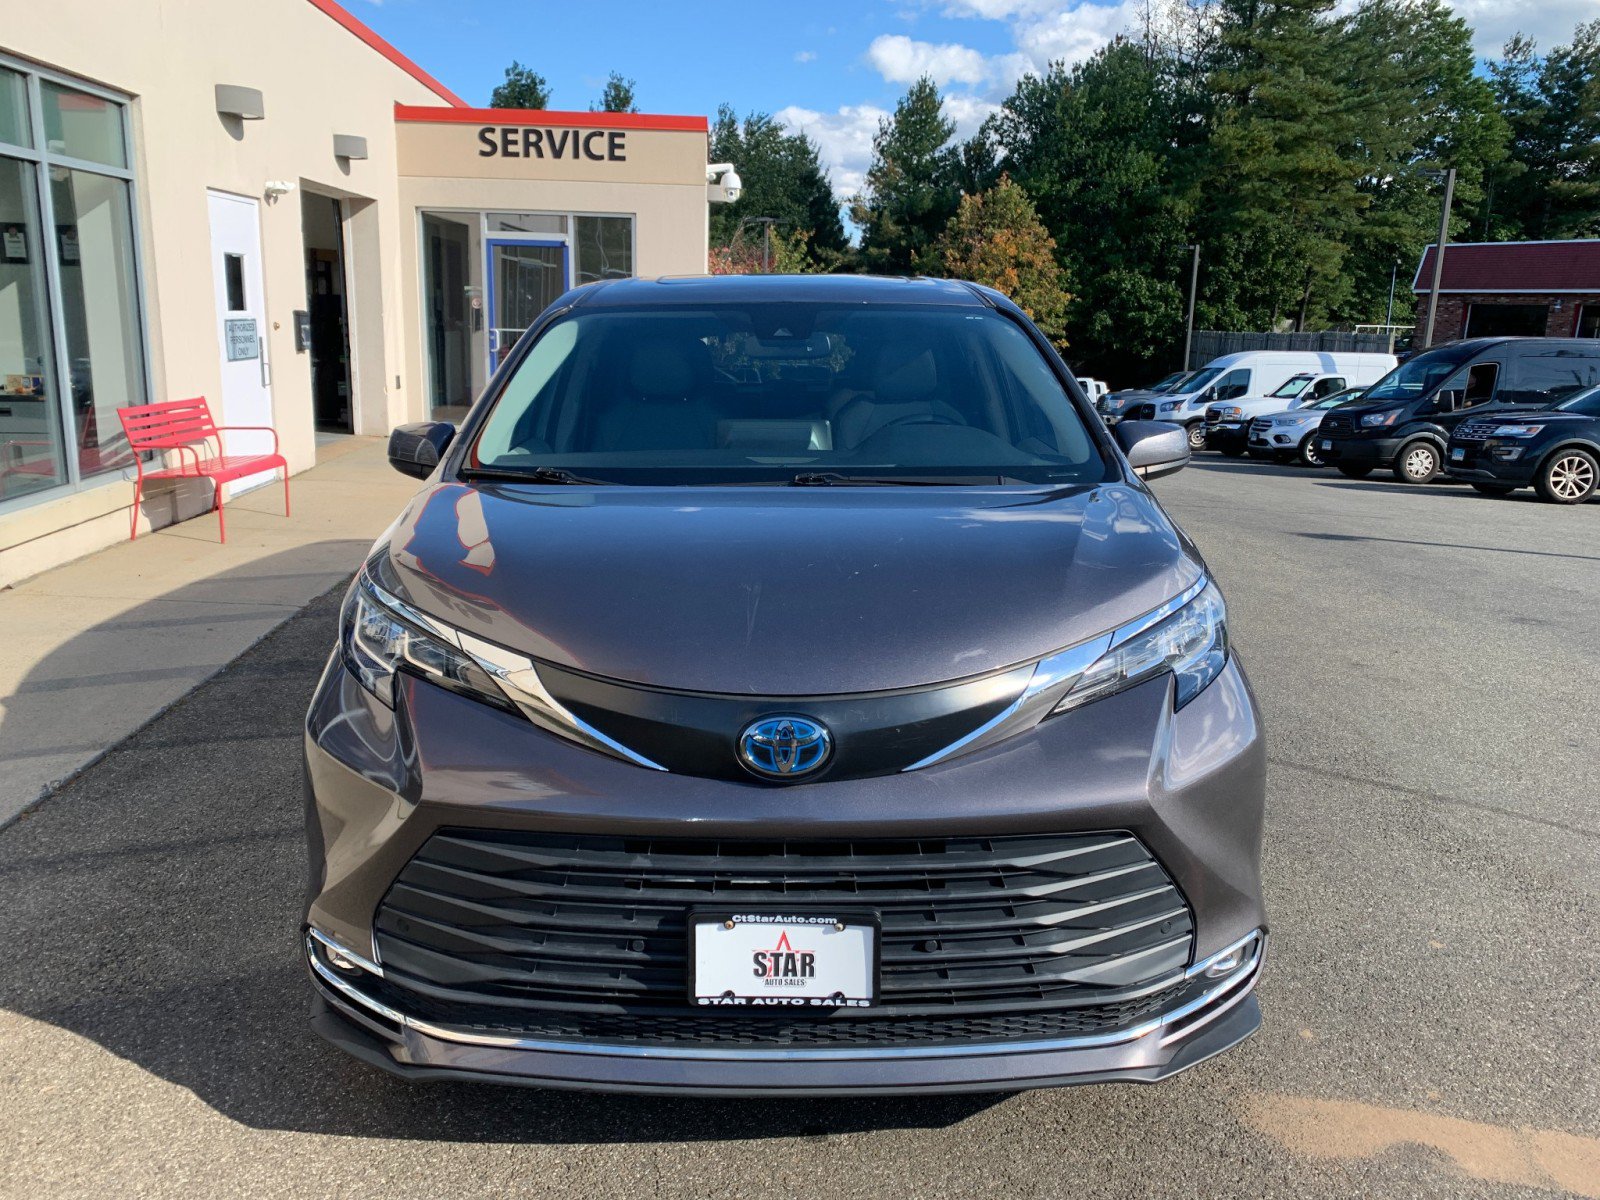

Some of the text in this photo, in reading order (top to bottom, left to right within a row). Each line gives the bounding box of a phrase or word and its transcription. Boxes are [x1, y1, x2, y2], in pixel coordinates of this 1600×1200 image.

[478, 127, 627, 162] SERVICE
[228, 322, 255, 332] AUTHORIZED
[230, 335, 256, 344] PERSONNEL
[237, 347, 249, 355] ONLY
[732, 914, 838, 924] CtStarAuto.com
[753, 952, 816, 978] STAR
[698, 998, 871, 1007] STAR AUTO SALES
